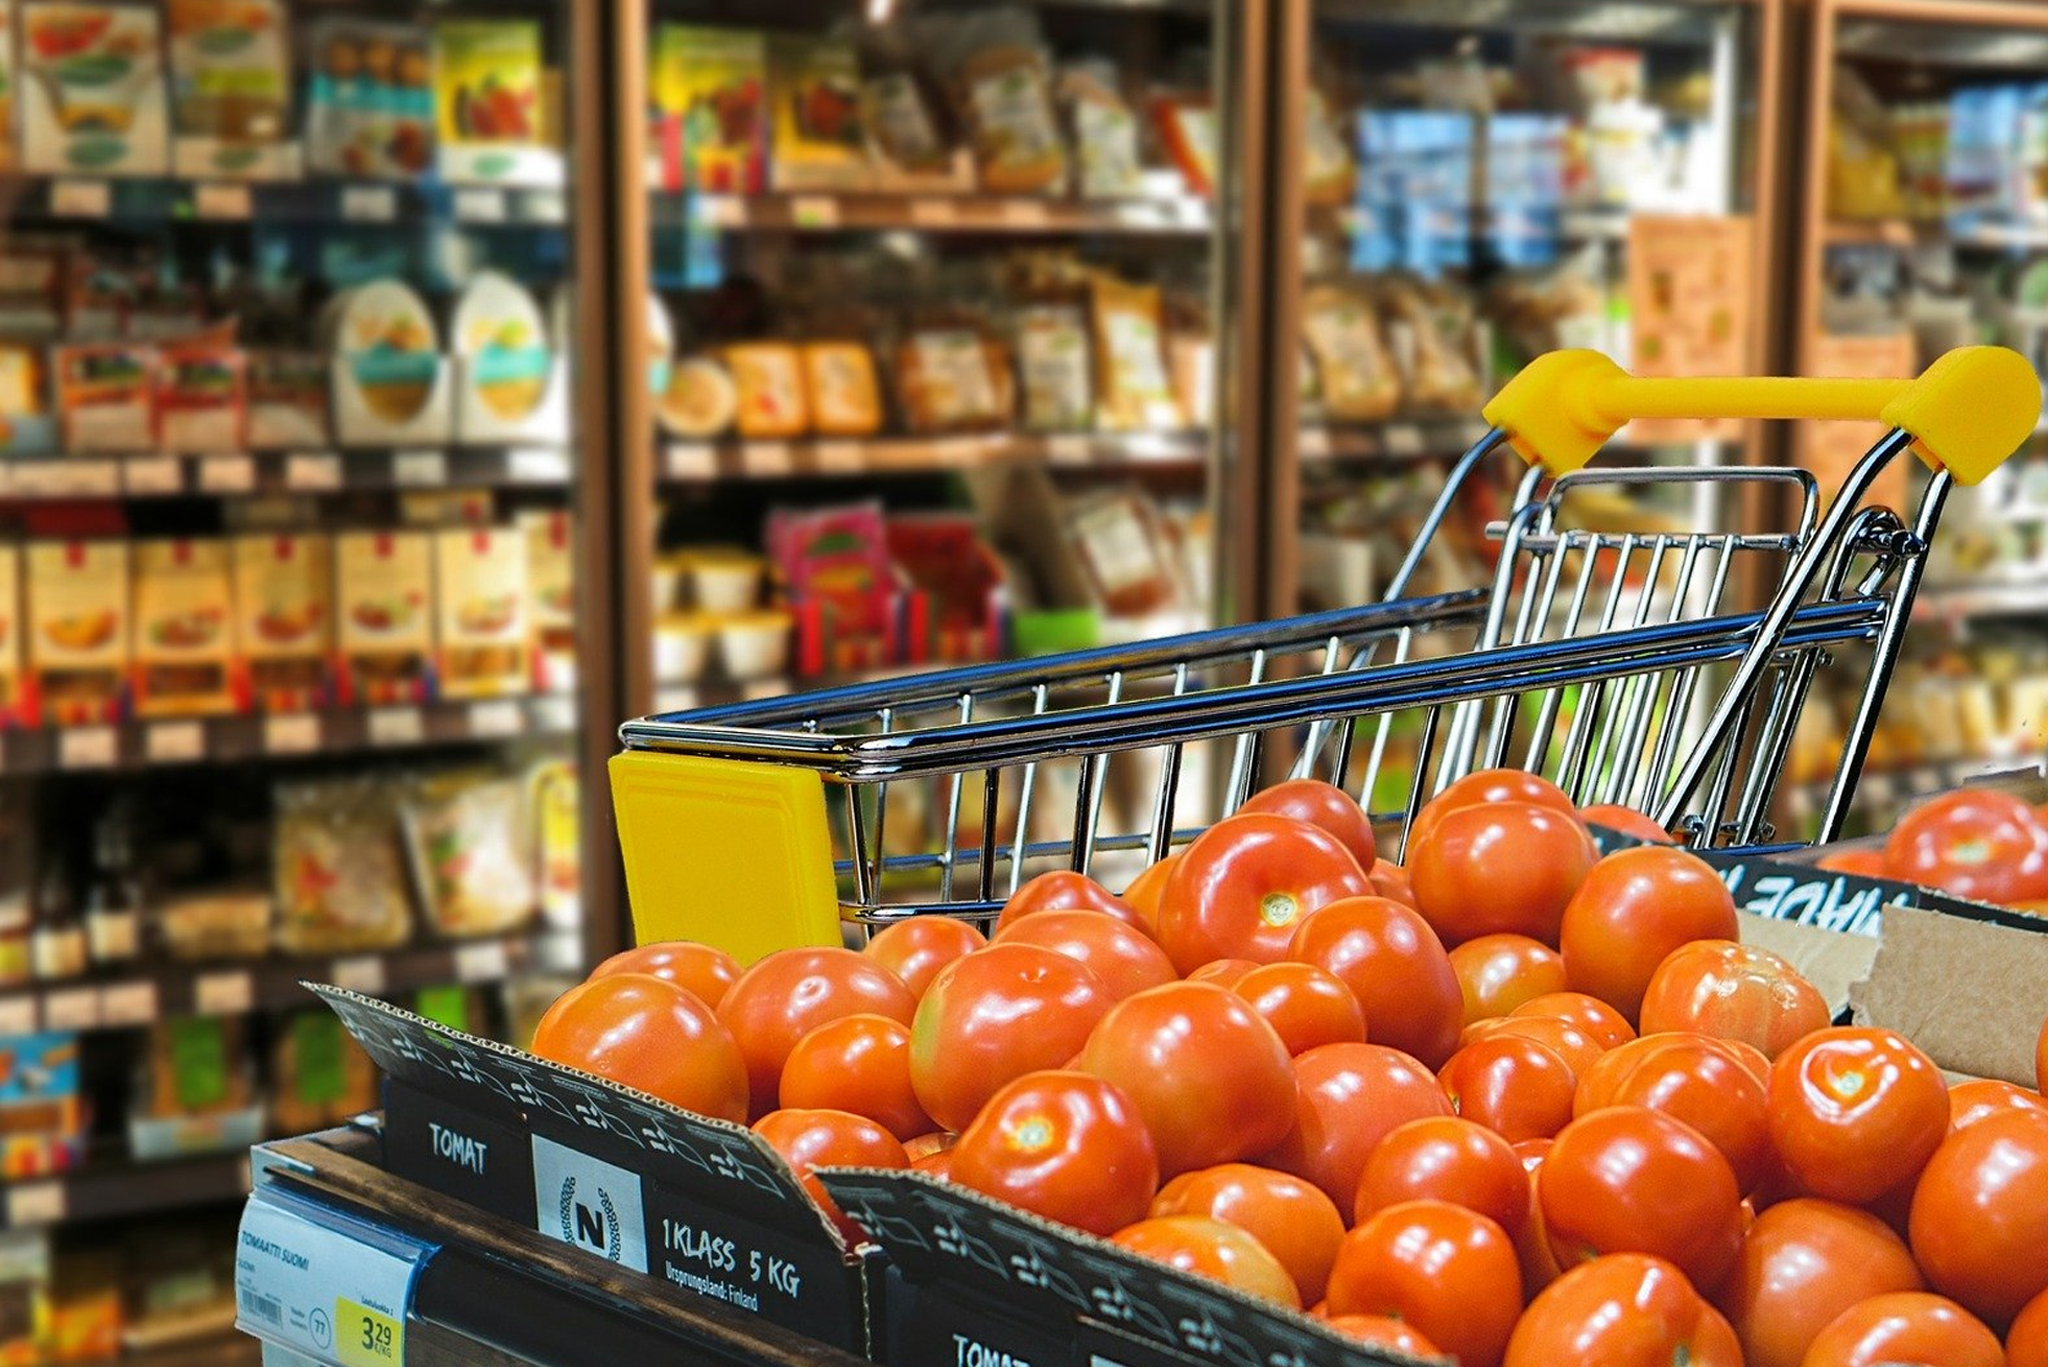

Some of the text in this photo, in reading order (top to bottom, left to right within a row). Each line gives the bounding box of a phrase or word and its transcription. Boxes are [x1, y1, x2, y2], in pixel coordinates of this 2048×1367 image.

[428, 1122, 487, 1175] TOMAT
[575, 1202, 605, 1250] N
[241, 1230, 310, 1271] TOMAATTI SUOMI
[662, 1218, 800, 1298] 1 KLASS 5 KG
[664, 1260, 758, 1312] Ursprungsland: Finland
[314, 1319, 326, 1335] 77
[362, 1316, 392, 1350] 3 29
[952, 1333, 1032, 1367] TOM
